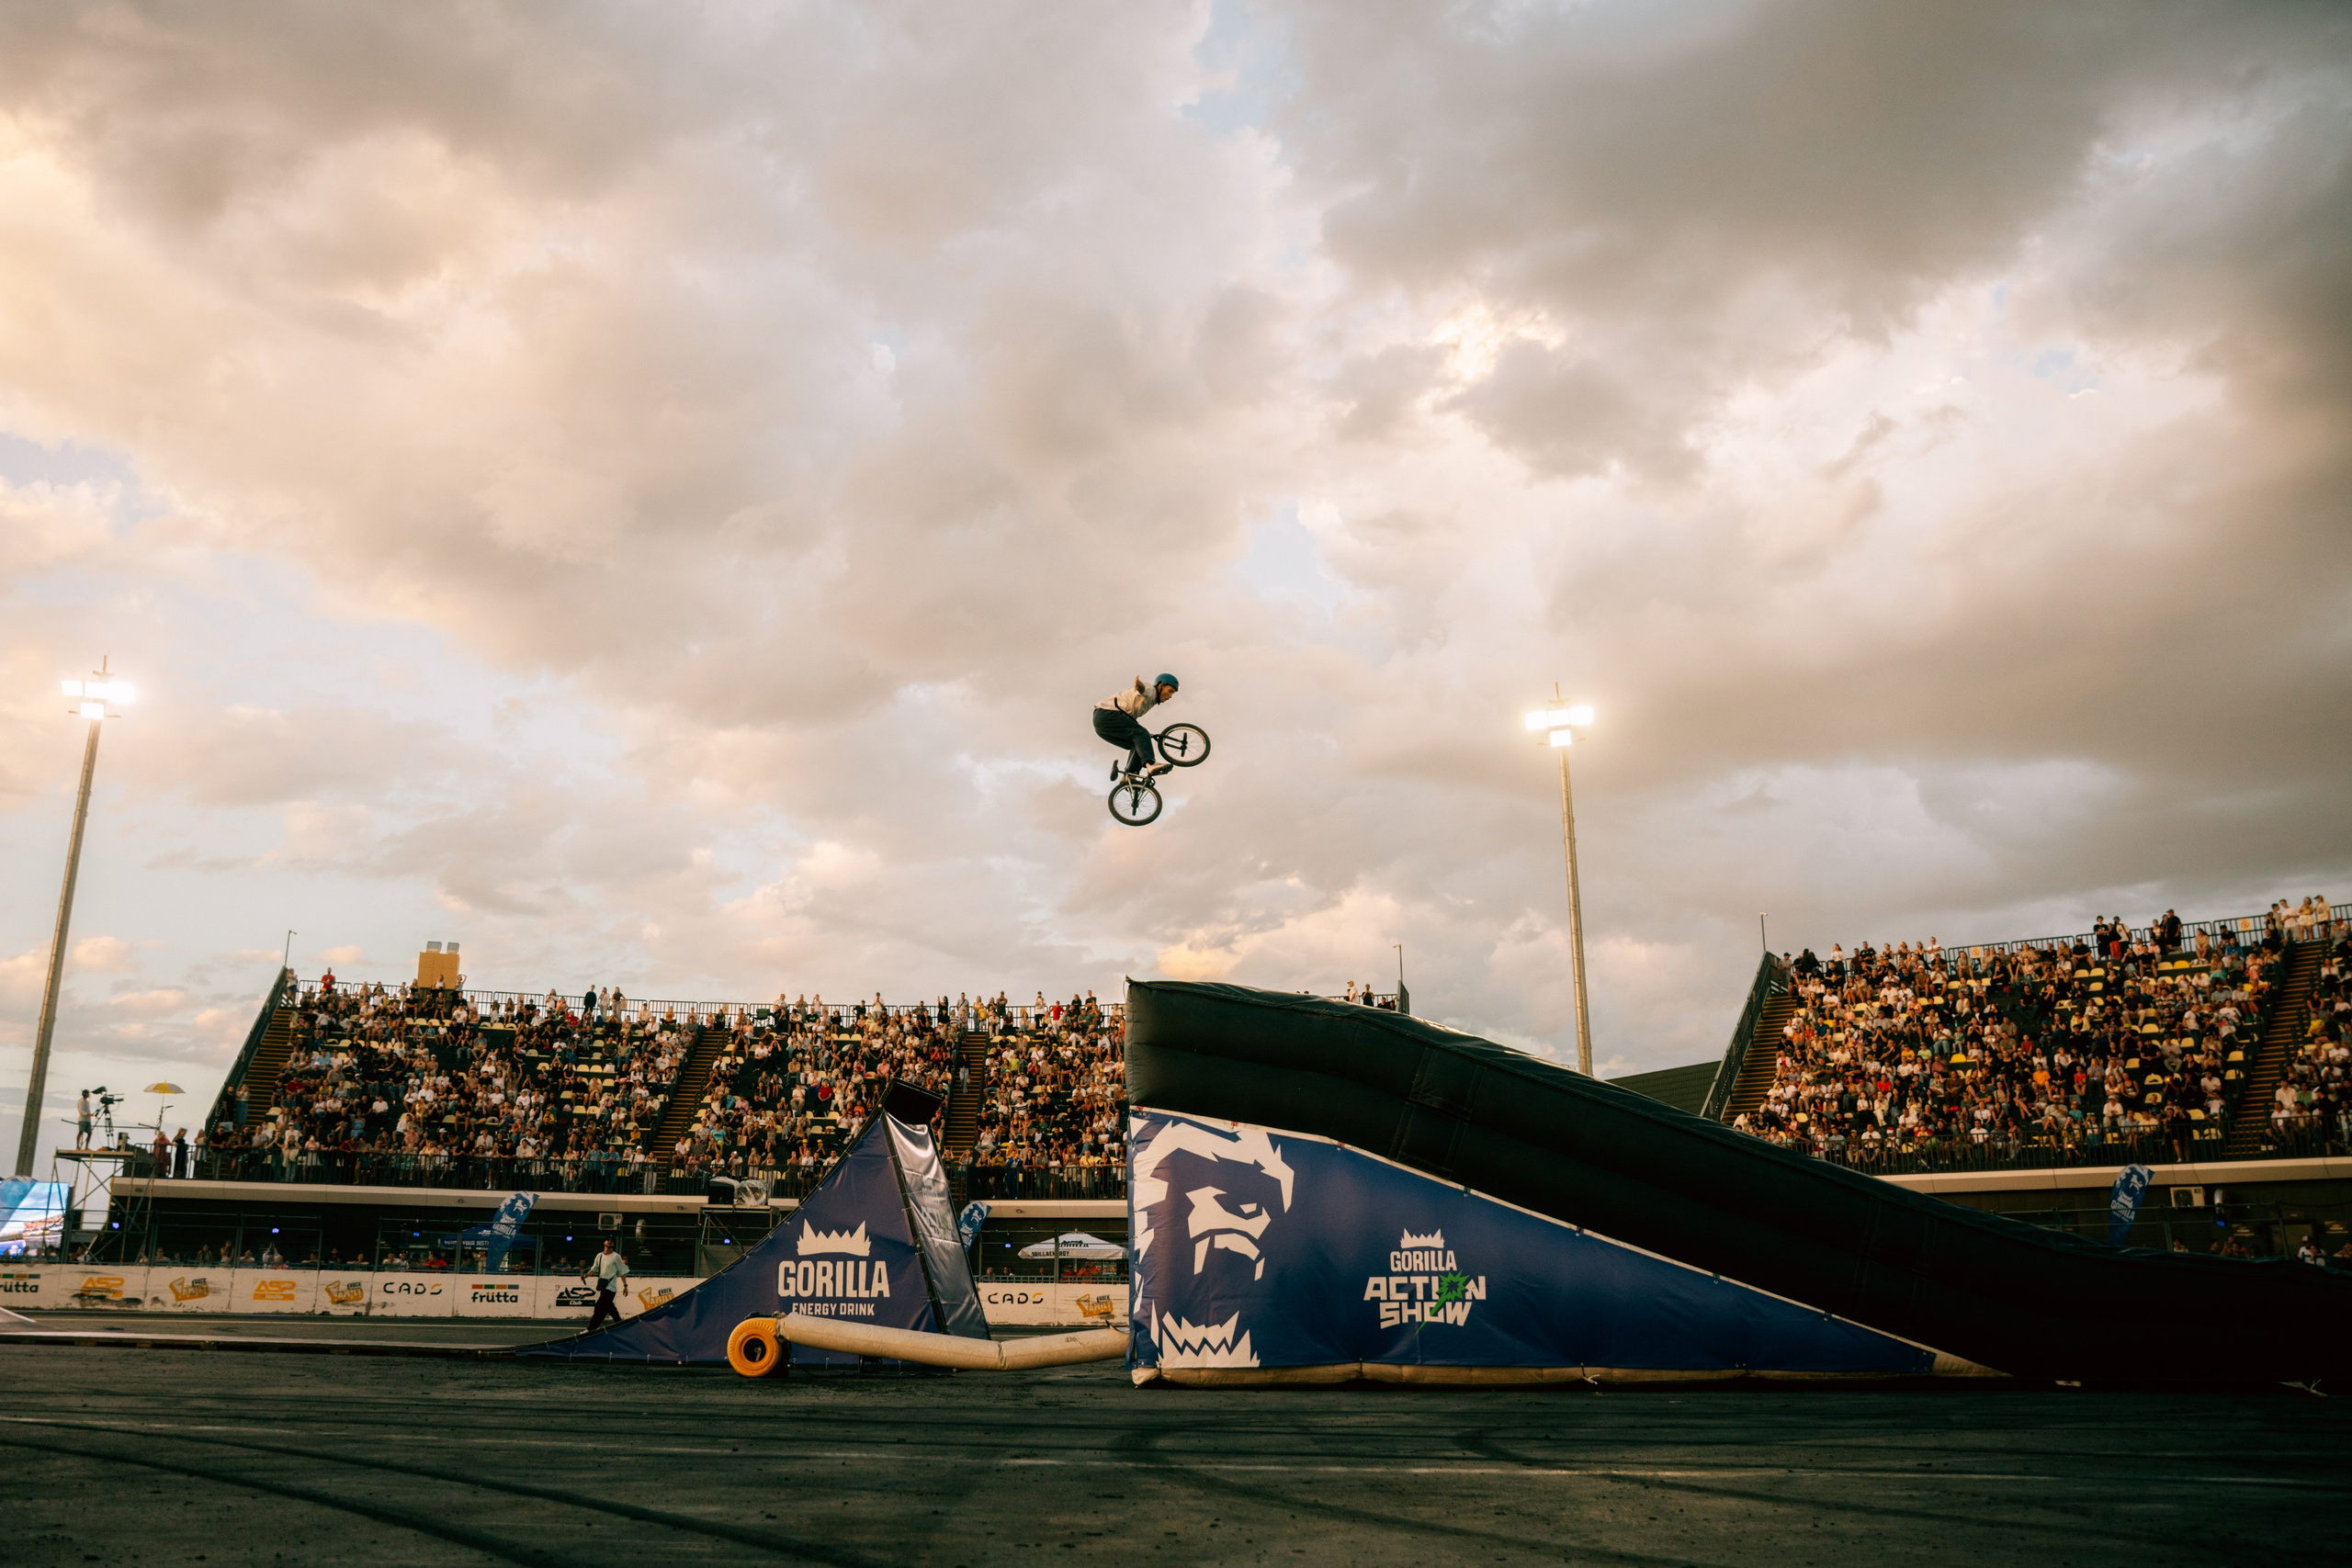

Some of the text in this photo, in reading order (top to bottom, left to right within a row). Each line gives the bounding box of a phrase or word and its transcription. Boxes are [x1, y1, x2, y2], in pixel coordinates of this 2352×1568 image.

[2110, 1200, 2136, 1221] GORILLA
[492, 1222, 517, 1238] GORILLA
[1390, 1250, 1457, 1271] GORILLA
[81, 1277, 125, 1289] ASP
[777, 1260, 890, 1297] GORILLA
[254, 1280, 296, 1292] ASP
[383, 1282, 443, 1294] CADS
[1363, 1275, 1487, 1301] ACTION
[471, 1292, 518, 1303] frütta
[557, 1287, 596, 1299] ASP
[988, 1292, 1044, 1304] CADS
[792, 1303, 875, 1316] ENERGY DRINK
[1379, 1302, 1473, 1329] SHOW
